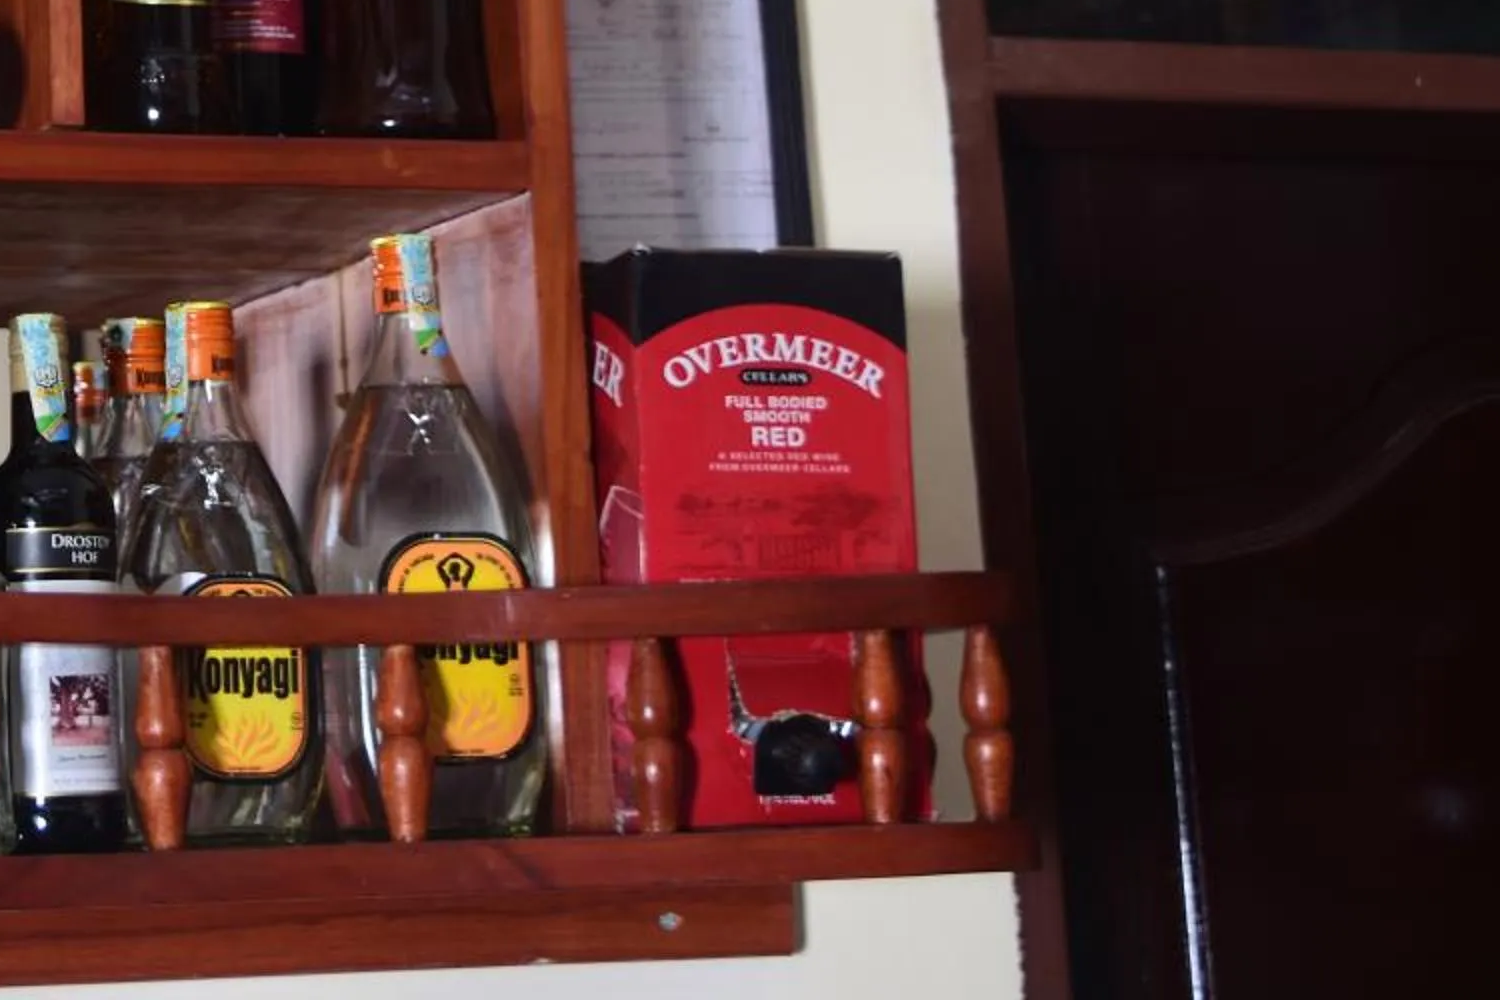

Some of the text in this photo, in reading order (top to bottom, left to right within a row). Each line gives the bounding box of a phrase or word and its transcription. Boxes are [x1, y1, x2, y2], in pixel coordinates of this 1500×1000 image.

[663, 332, 886, 400] OVERMEER
[742, 371, 809, 384] CELLARS
[724, 395, 829, 410] FULL BODIED
[743, 409, 811, 424] SMOOTH
[751, 426, 806, 447] RED
[187, 649, 300, 703] Konyagi
